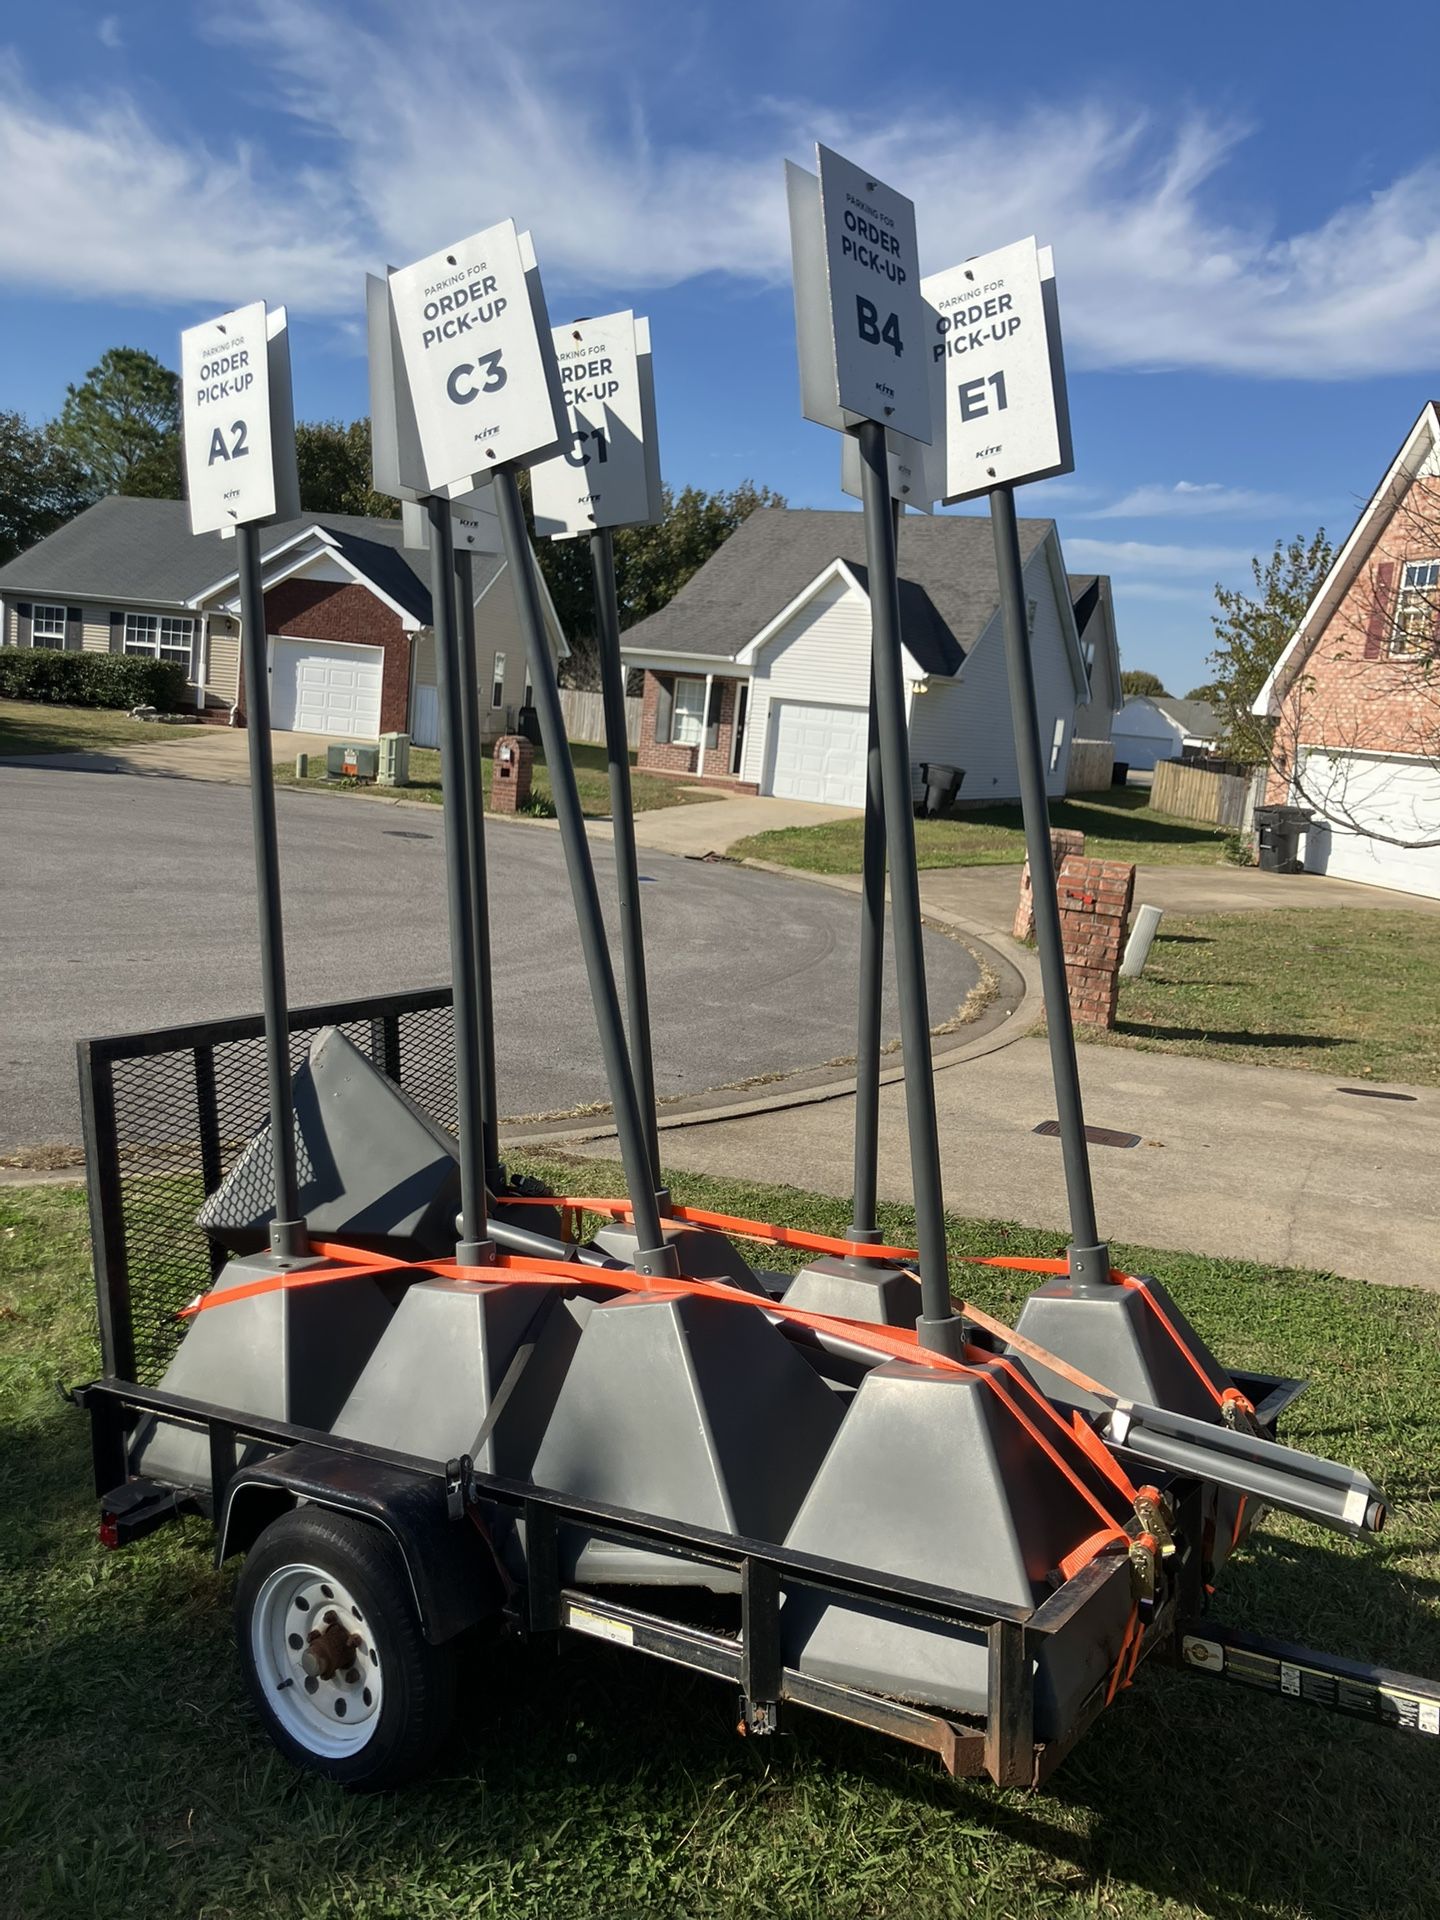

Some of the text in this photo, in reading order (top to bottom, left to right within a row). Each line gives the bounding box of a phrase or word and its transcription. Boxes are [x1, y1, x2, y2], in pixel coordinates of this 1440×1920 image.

[846, 193, 895, 228] PARKING FOR
[844, 210, 901, 259] ORDER
[424, 262, 488, 297] PARKING FOR
[841, 235, 906, 285] PICK-UP
[423, 275, 498, 321] ORDER
[936, 293, 1013, 335] ORDER
[938, 279, 1005, 310] PARKING FOR
[422, 297, 508, 349] PICK-UP
[856, 294, 904, 358] B4
[932, 316, 1022, 363] PICK-UP
[200, 350, 249, 381] ORDER
[202, 336, 245, 359] PARKING FOR
[588, 344, 606, 355] FOR
[197, 372, 254, 406] PICK-UP
[446, 348, 508, 405] C3
[560, 358, 613, 384] RDER
[563, 381, 619, 406] CK-UP
[957, 370, 1008, 423] E1
[208, 420, 249, 467] A2
[563, 426, 608, 468] C1
